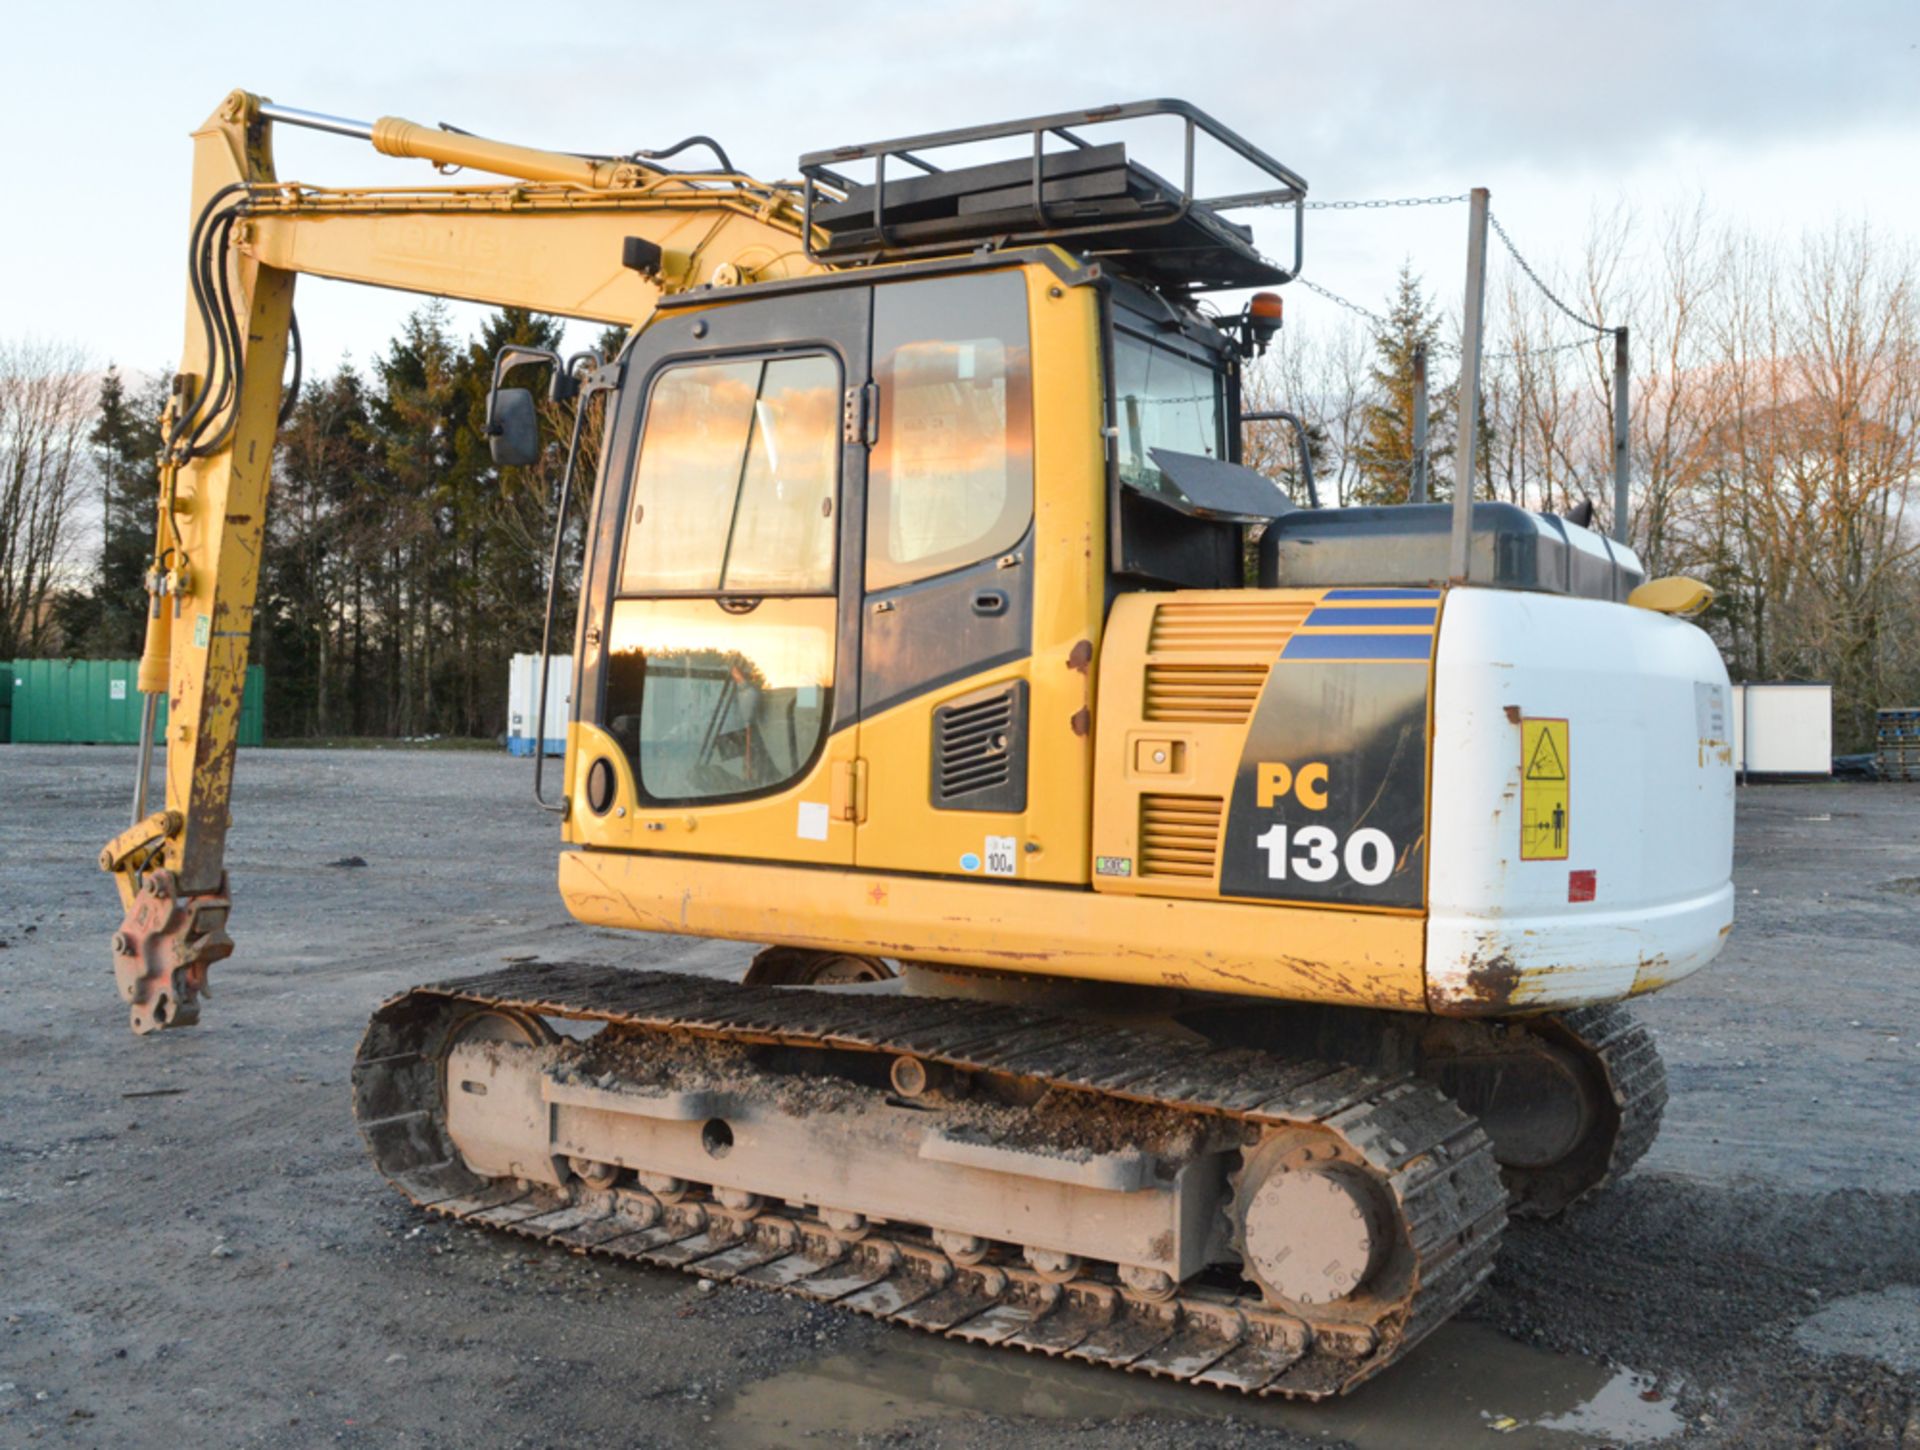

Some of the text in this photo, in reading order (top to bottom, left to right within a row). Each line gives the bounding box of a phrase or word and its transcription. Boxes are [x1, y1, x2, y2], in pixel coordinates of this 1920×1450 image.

[1257, 762, 1328, 810] PC
[989, 853, 1007, 872] 100
[1257, 824, 1395, 886] 130
